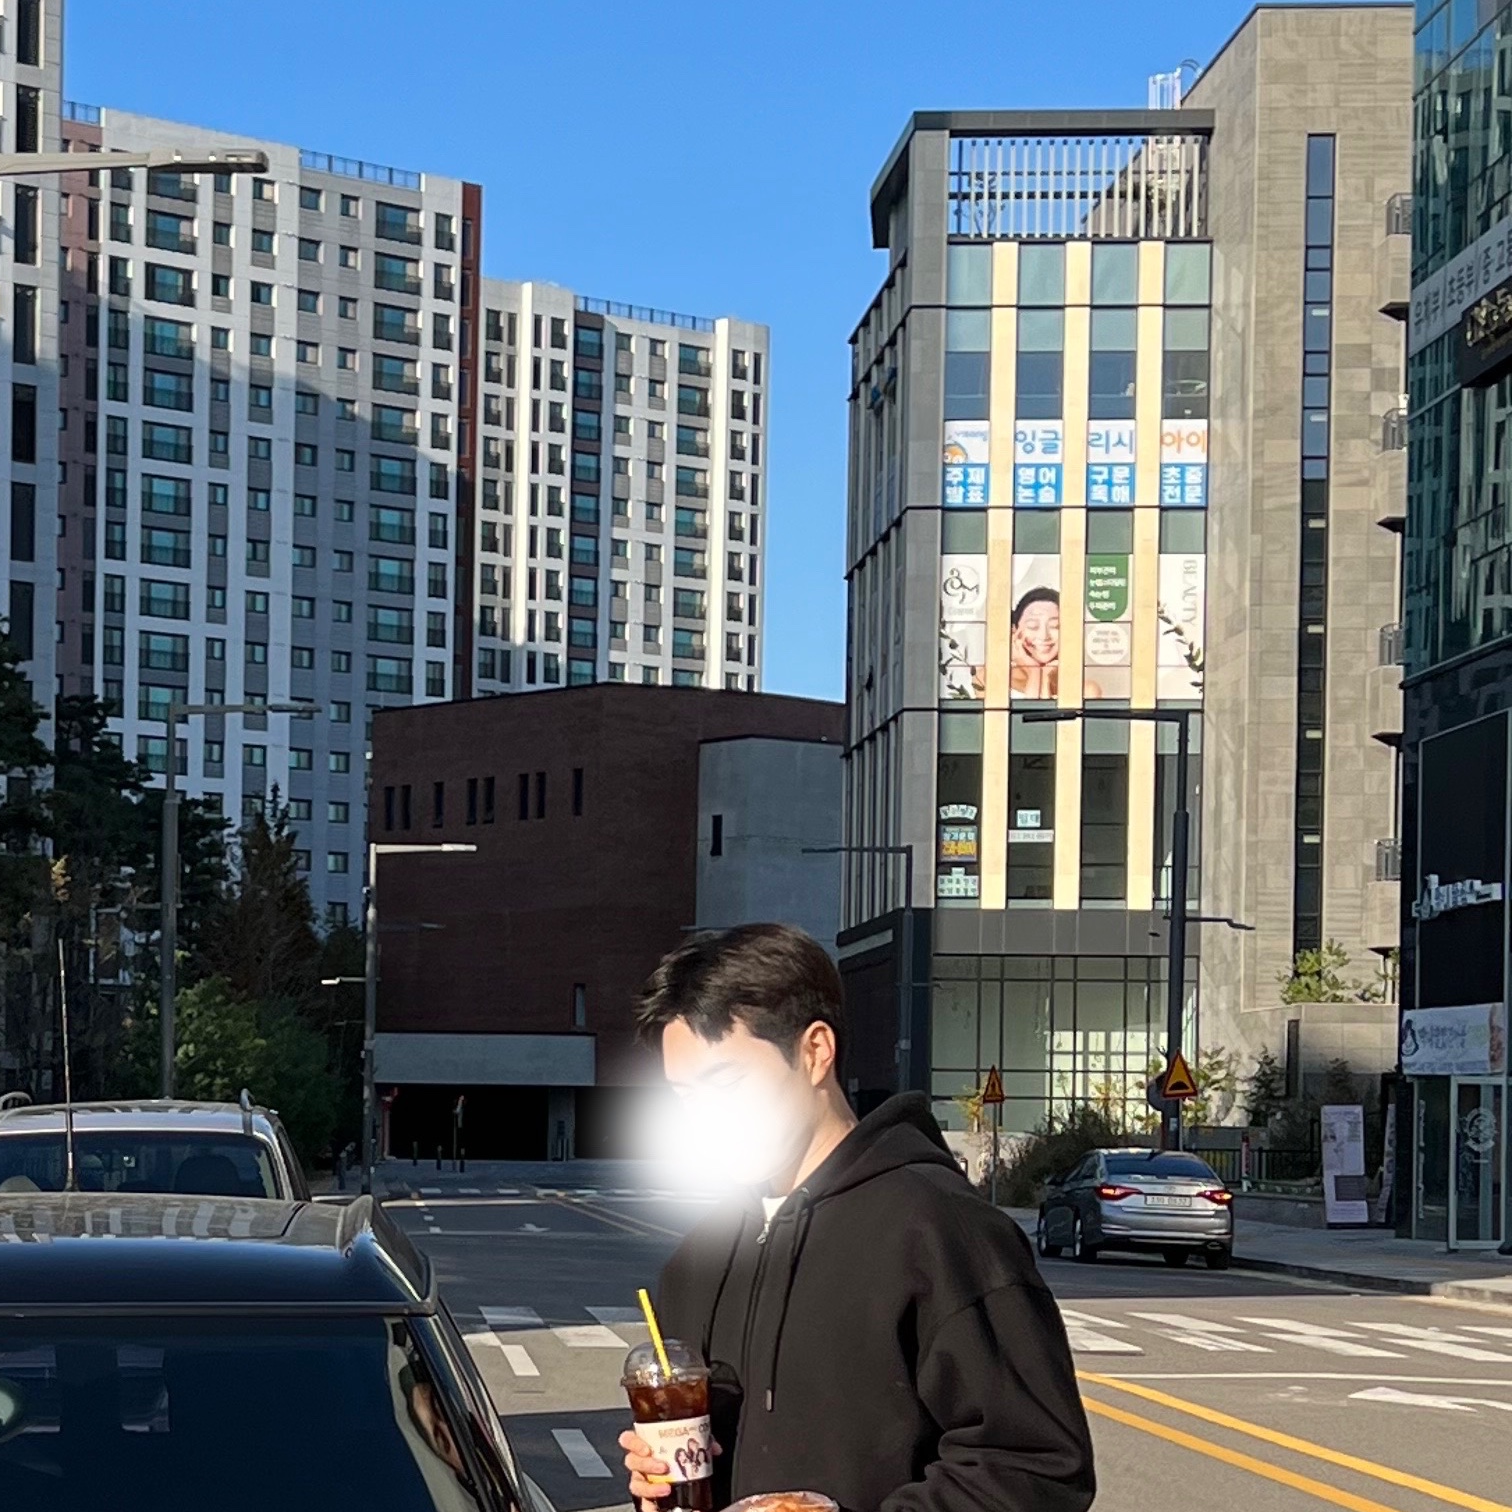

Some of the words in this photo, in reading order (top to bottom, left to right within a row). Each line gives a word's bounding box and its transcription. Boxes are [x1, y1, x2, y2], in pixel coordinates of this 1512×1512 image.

[1015, 429, 1063, 455] 잉글
[1088, 429, 1134, 455] 리시
[1161, 429, 1208, 455] 아이
[1017, 467, 1056, 484] 영어
[1182, 559, 1199, 627] BEAUTY
